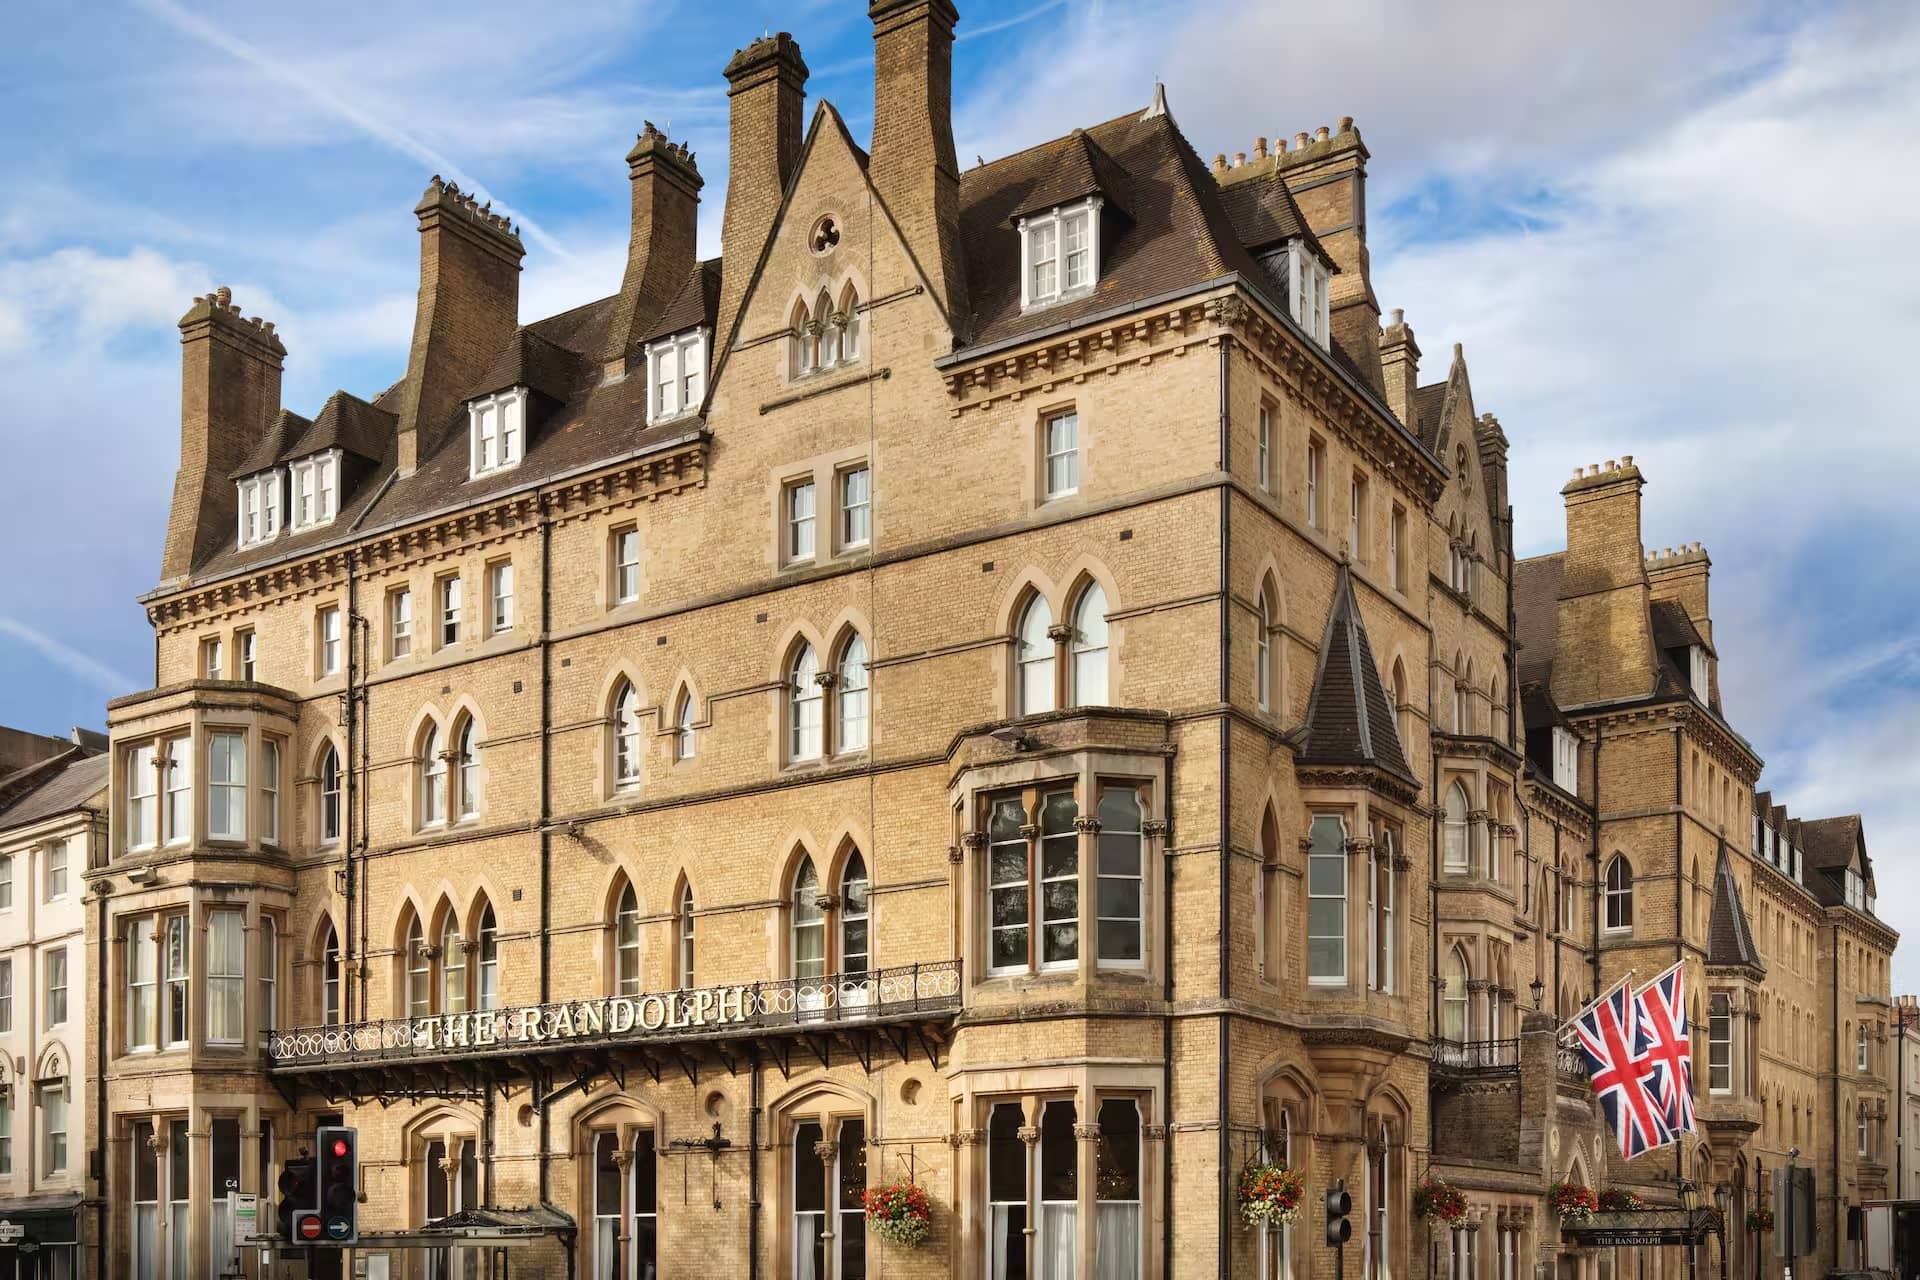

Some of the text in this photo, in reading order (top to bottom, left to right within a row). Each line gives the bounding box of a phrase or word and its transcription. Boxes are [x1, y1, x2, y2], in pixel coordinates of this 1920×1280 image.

[420, 987, 746, 1050] THE RANDOLPH
[225, 1179, 238, 1189] C4
[1596, 1236, 1661, 1245] THE RANDOLPH
